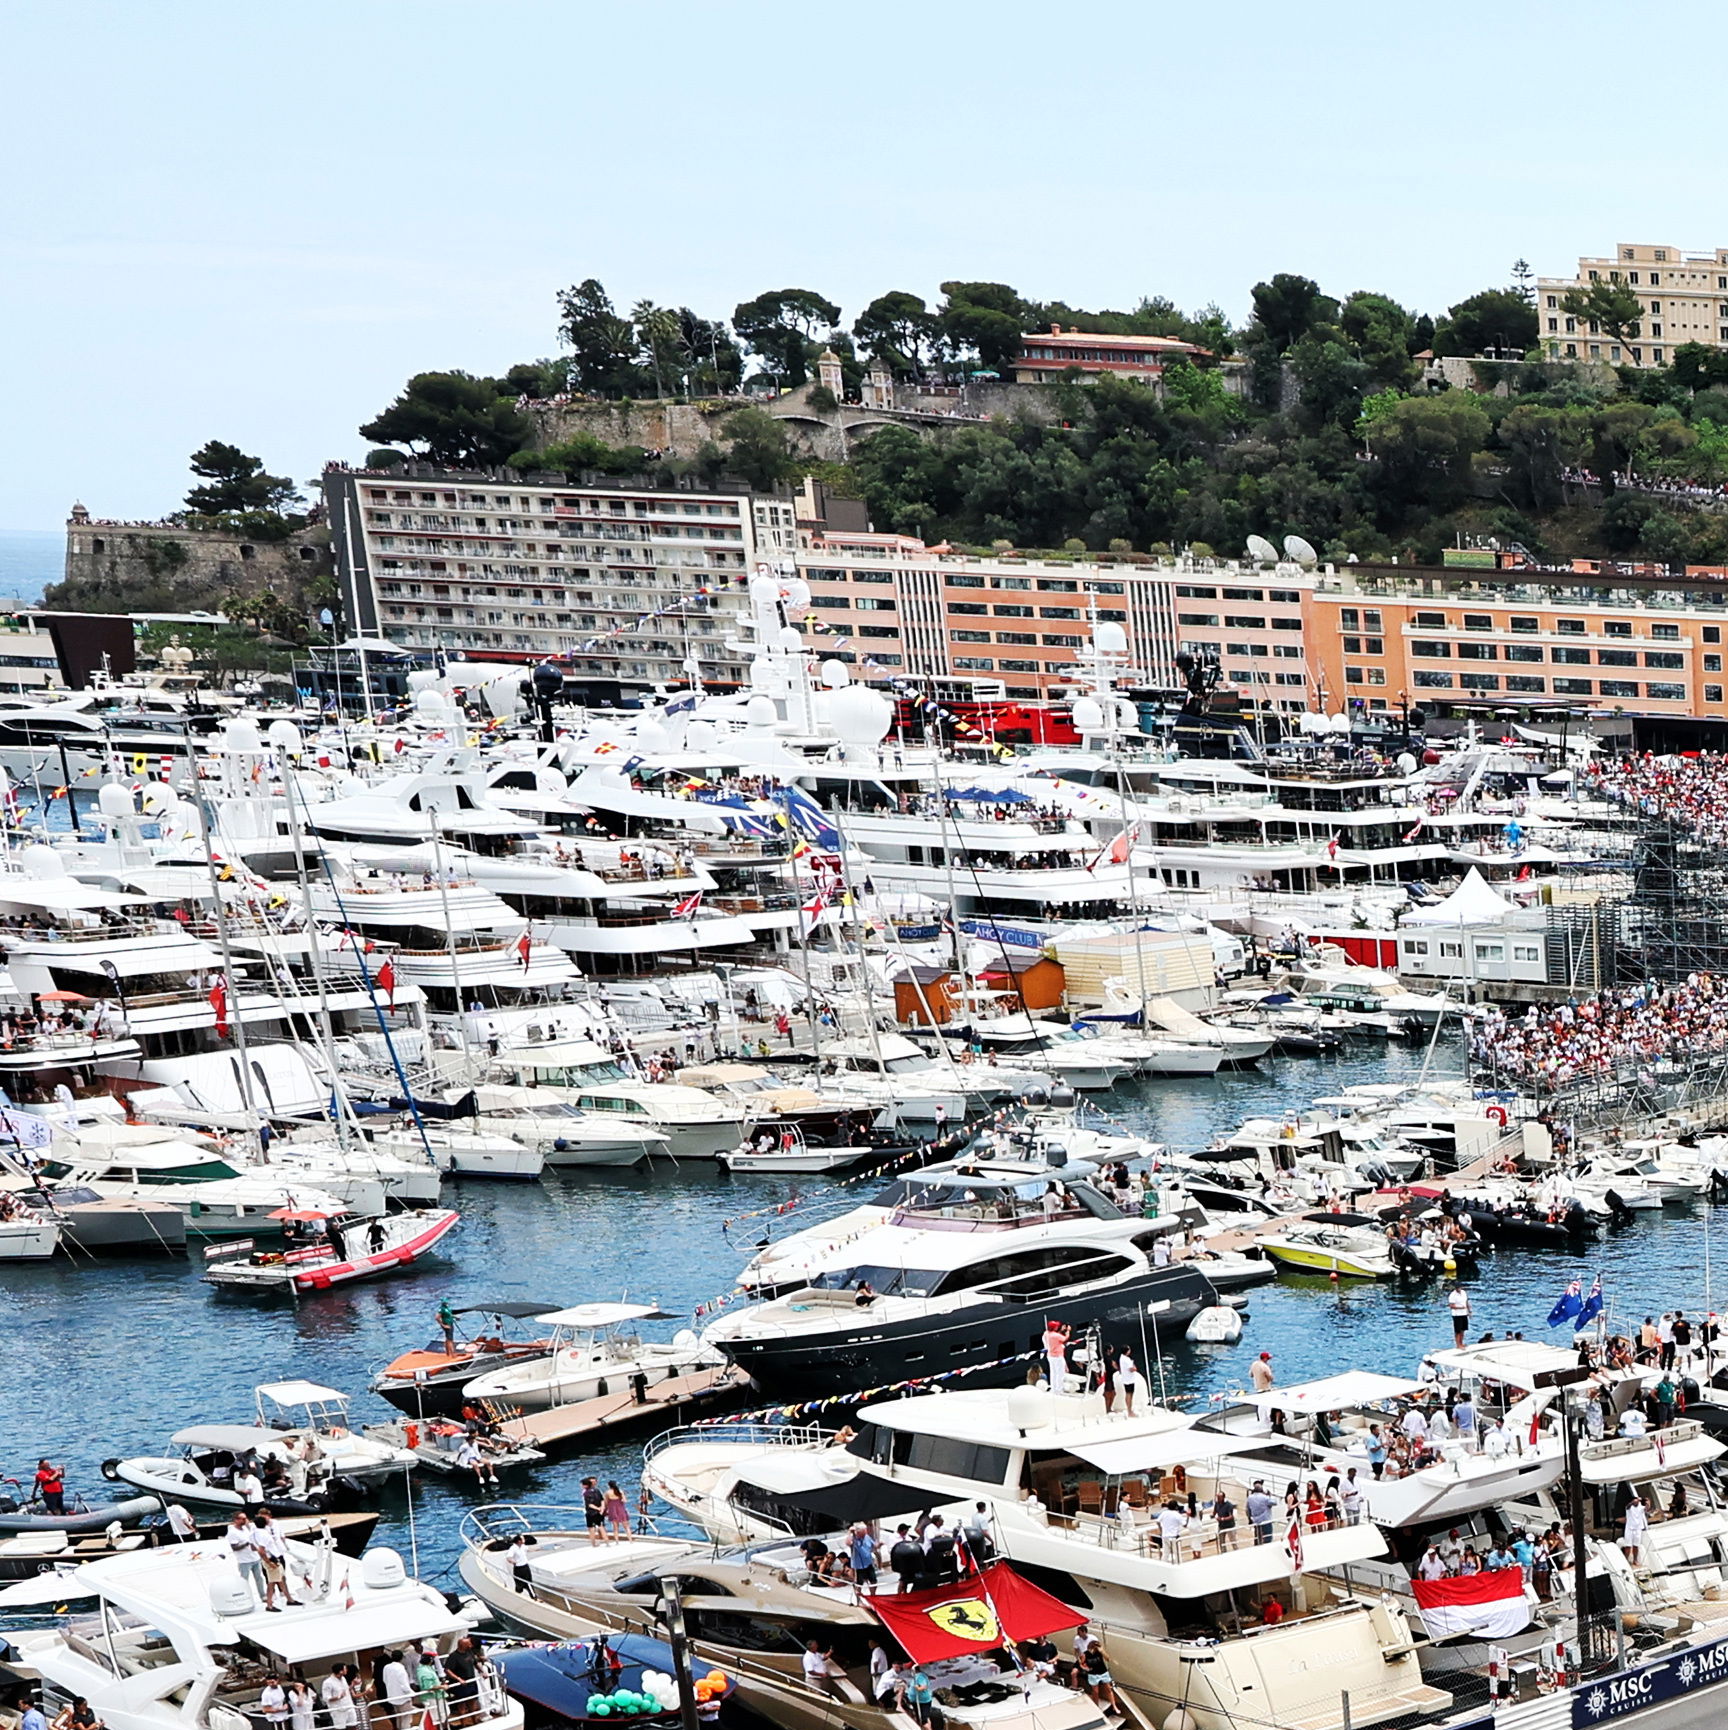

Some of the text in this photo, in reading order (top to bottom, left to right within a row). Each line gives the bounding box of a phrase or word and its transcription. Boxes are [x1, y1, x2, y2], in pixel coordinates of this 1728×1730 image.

[900, 929, 922, 938] AHOY
[975, 927, 1033, 945] AHOY CLUB
[1608, 1672, 1652, 1706] MSC
